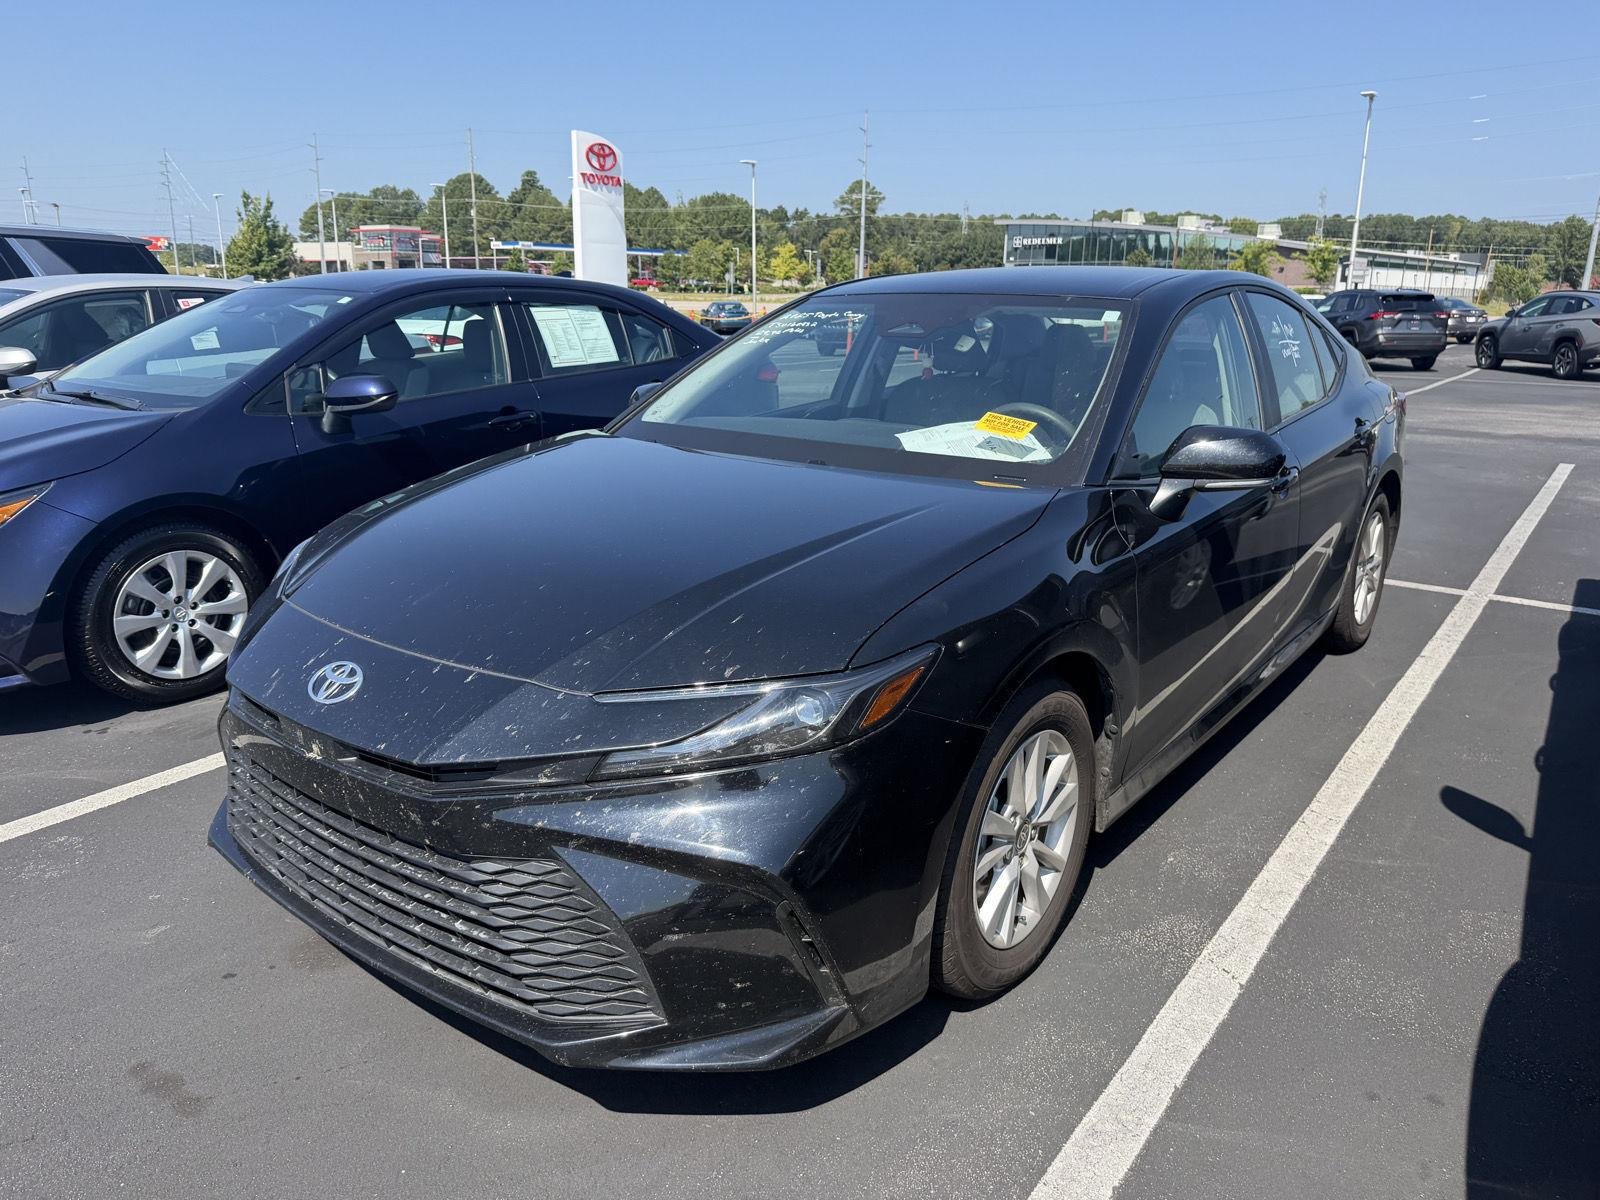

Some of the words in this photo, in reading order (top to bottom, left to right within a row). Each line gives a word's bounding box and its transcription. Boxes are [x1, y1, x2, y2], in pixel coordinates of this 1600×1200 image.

[580, 172, 622, 187] TOYOTA
[1022, 236, 1063, 246] REDEEMER
[987, 413, 1004, 421] THIS
[1004, 417, 1031, 428] VEHICLE
